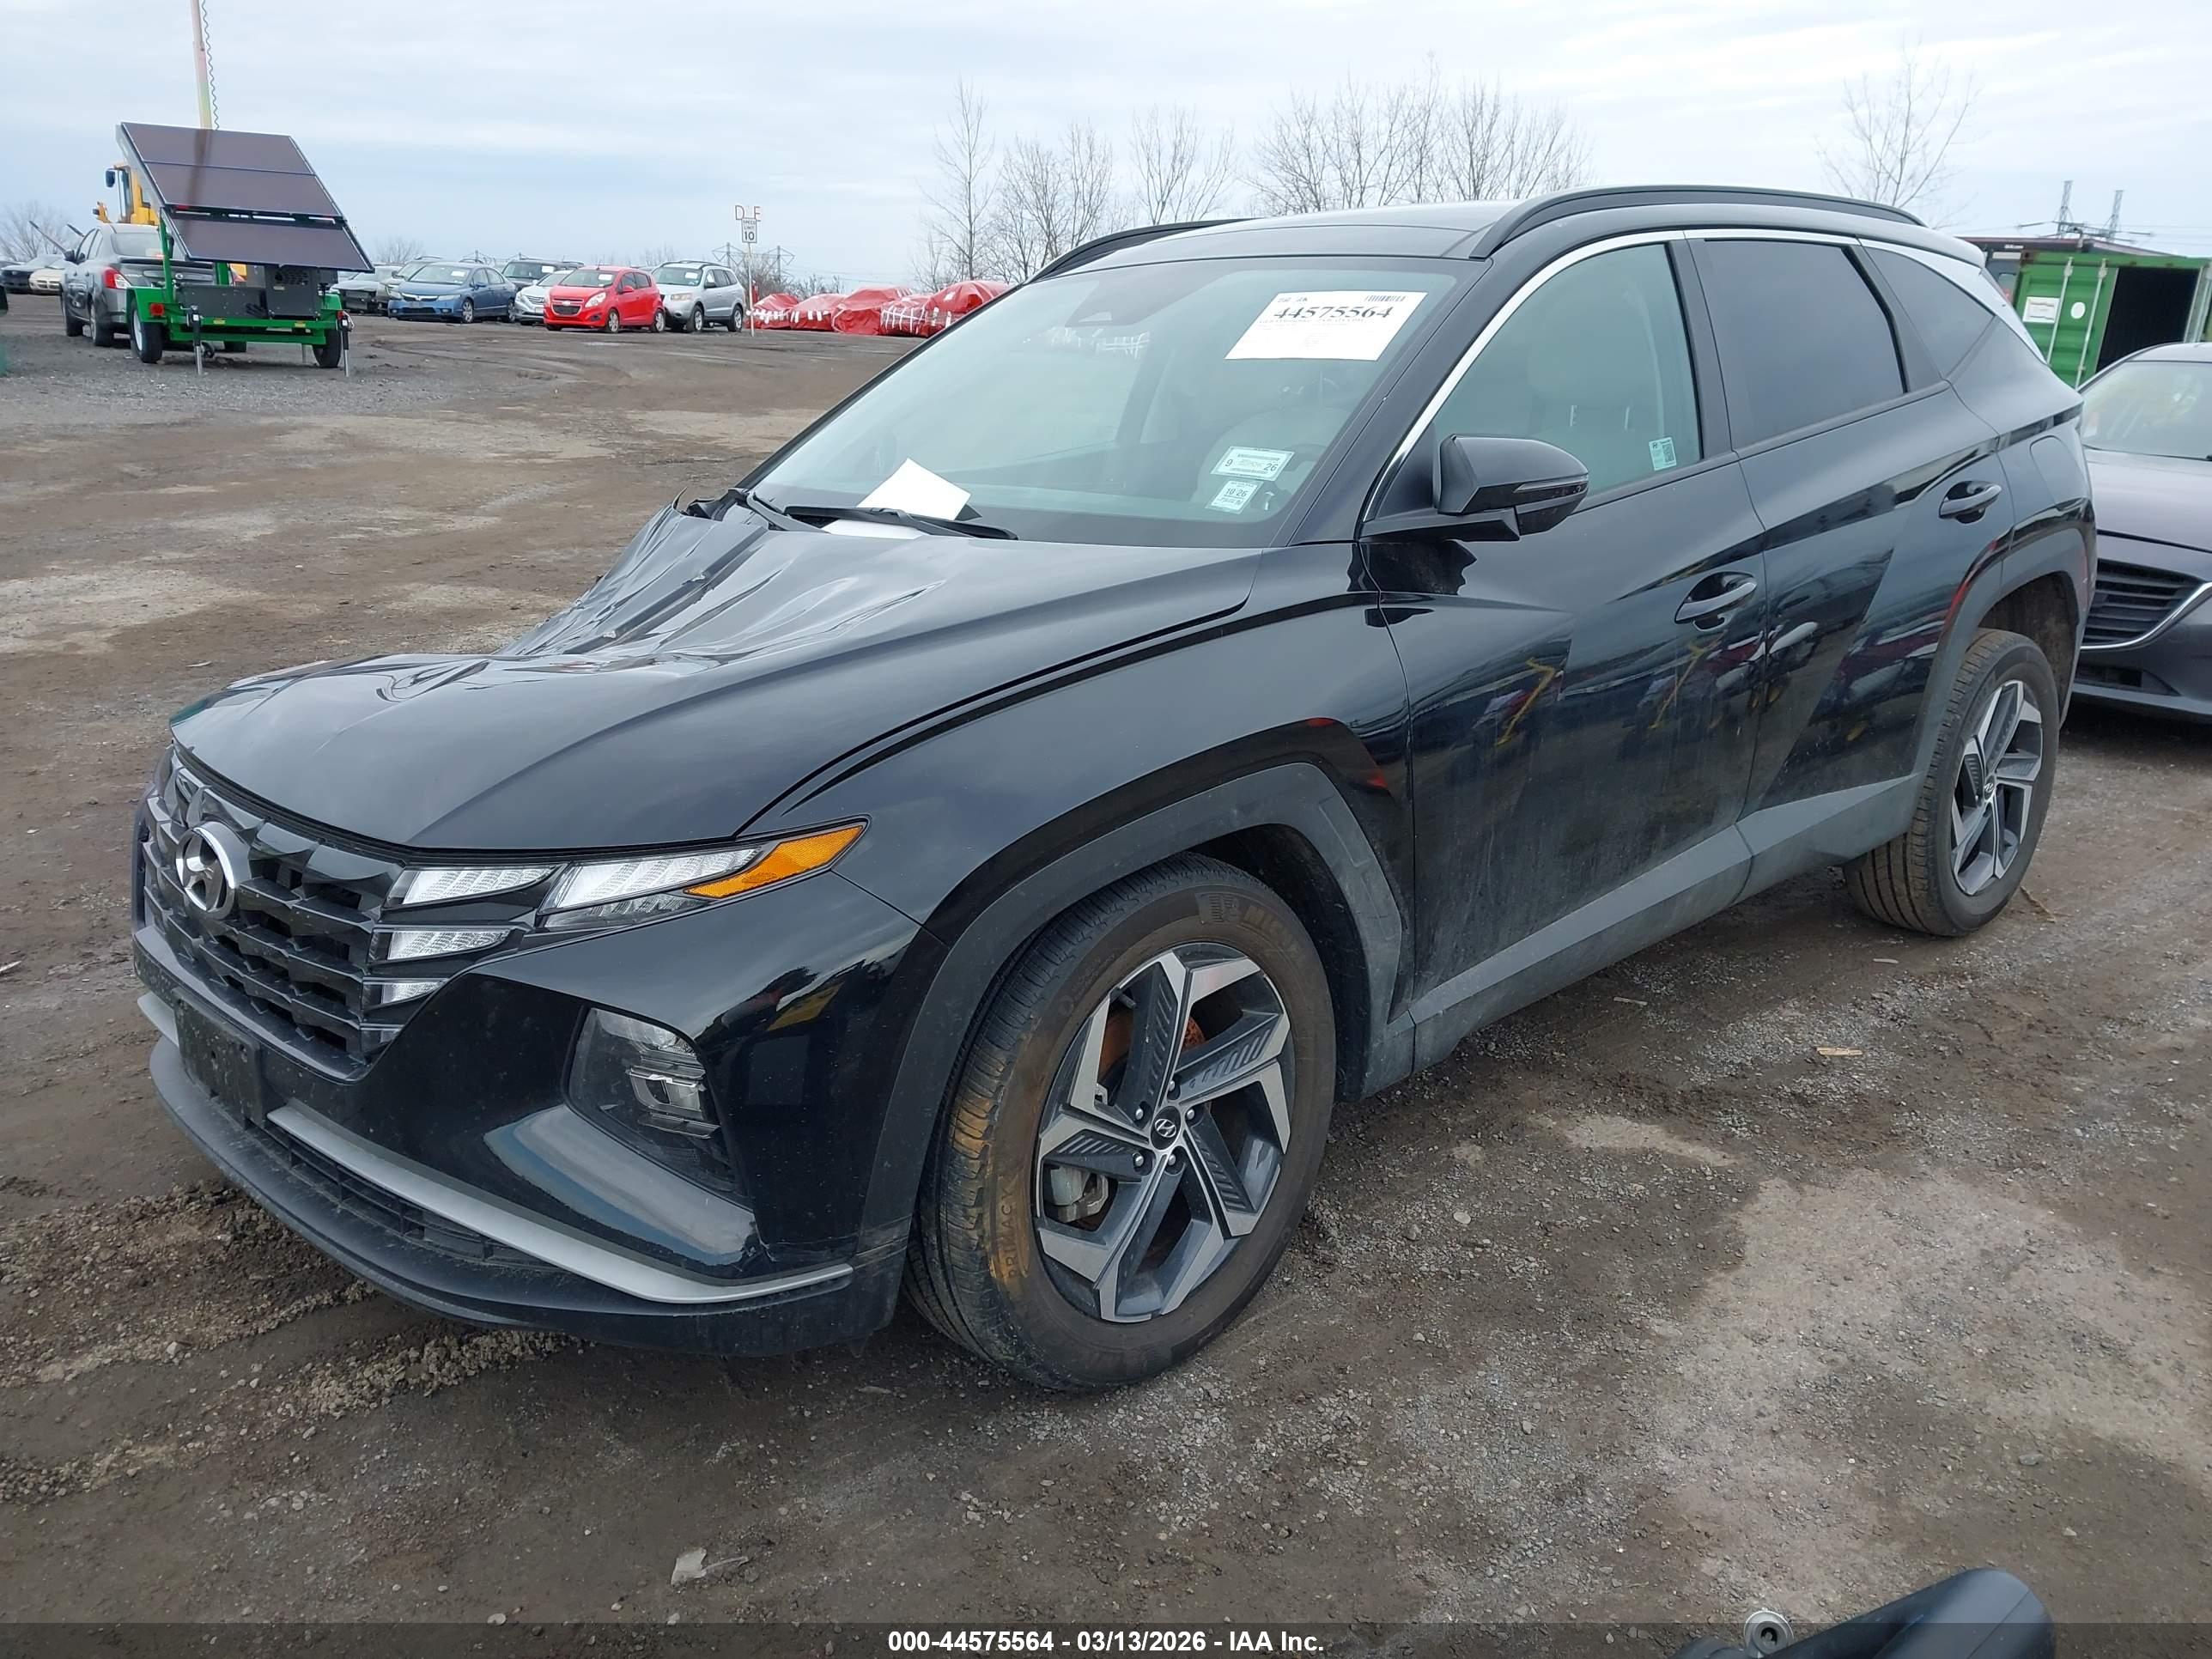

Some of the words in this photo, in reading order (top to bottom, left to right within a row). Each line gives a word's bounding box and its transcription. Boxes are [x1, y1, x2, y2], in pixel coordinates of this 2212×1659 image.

[744, 231, 755, 240] 10
[1274, 306, 1394, 319] 44575564
[1224, 459, 1233, 467] 9
[1263, 463, 1279, 471] 26
[1000, 1188, 1019, 1279] PRIMACY
